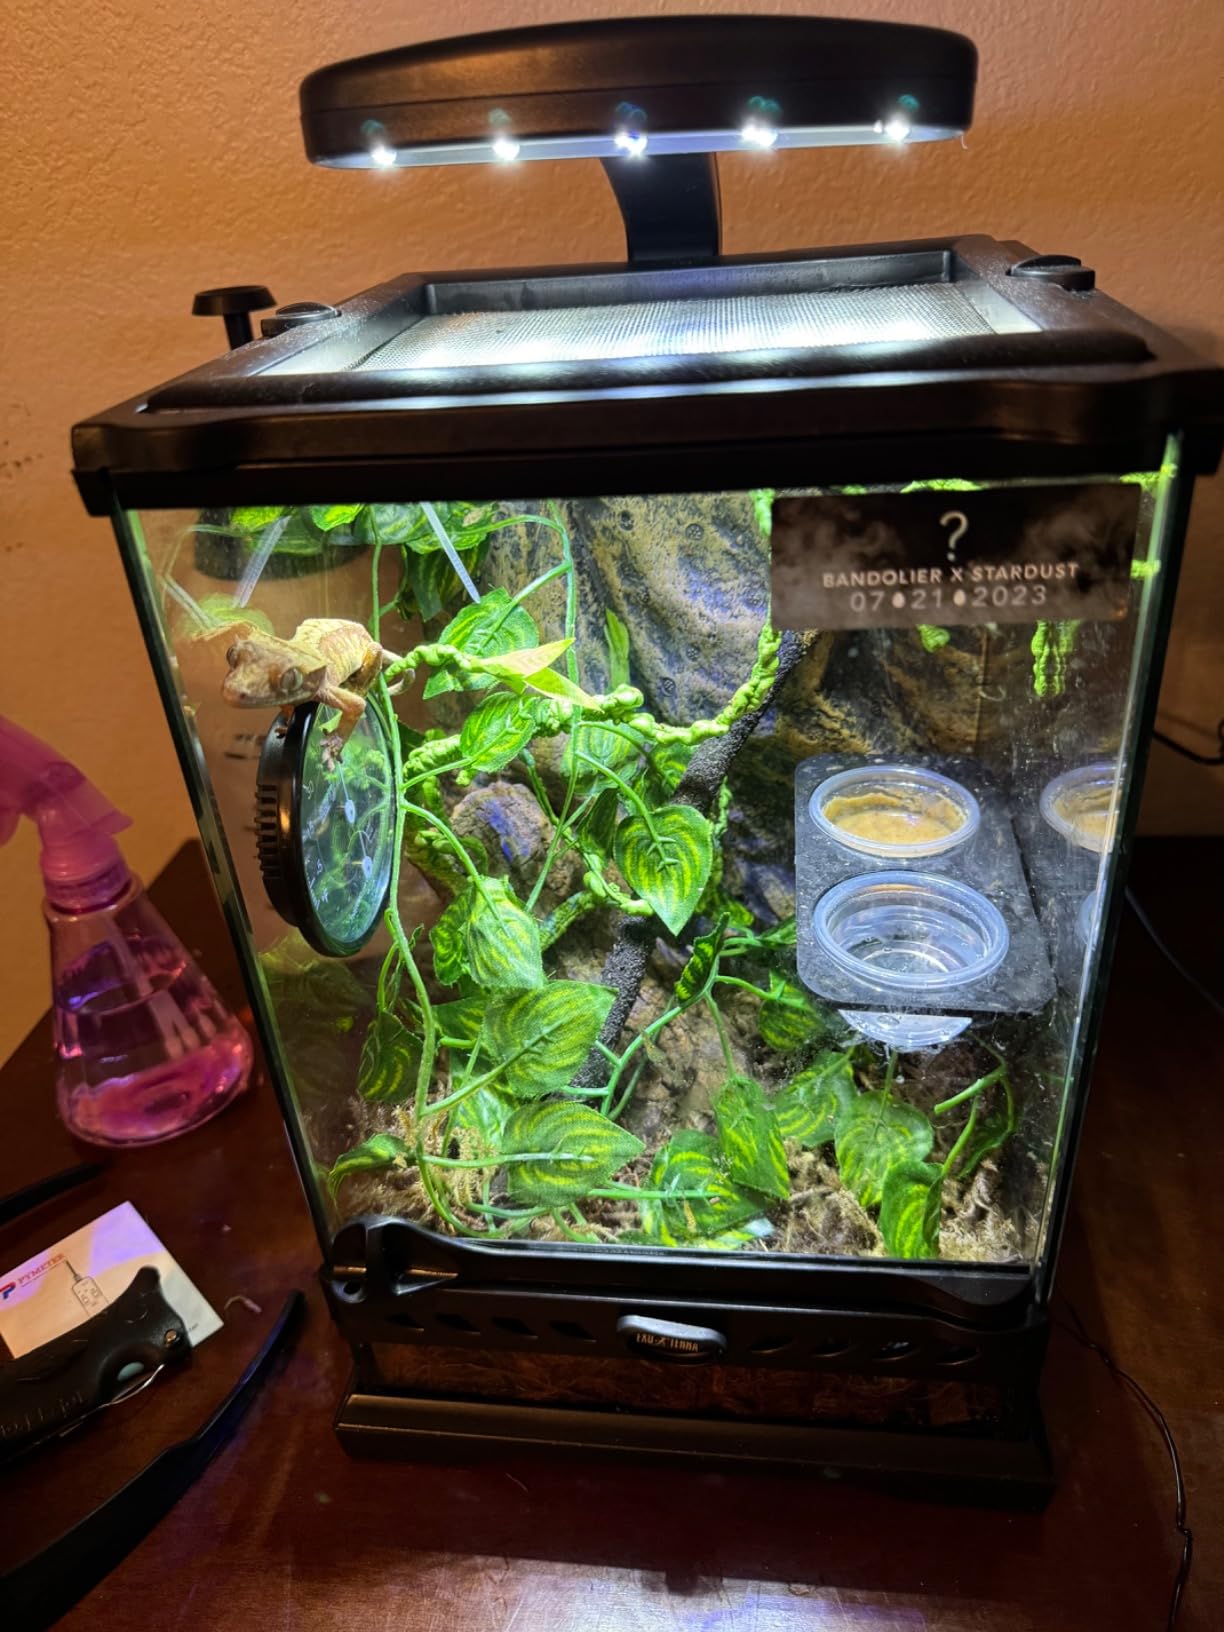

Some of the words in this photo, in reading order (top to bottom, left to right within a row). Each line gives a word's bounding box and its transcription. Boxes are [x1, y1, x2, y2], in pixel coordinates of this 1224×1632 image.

[939, 510, 969, 562] ?
[822, 567, 943, 589] BANDOLIER
[950, 566, 964, 583] X
[971, 562, 1080, 583] STARDUST
